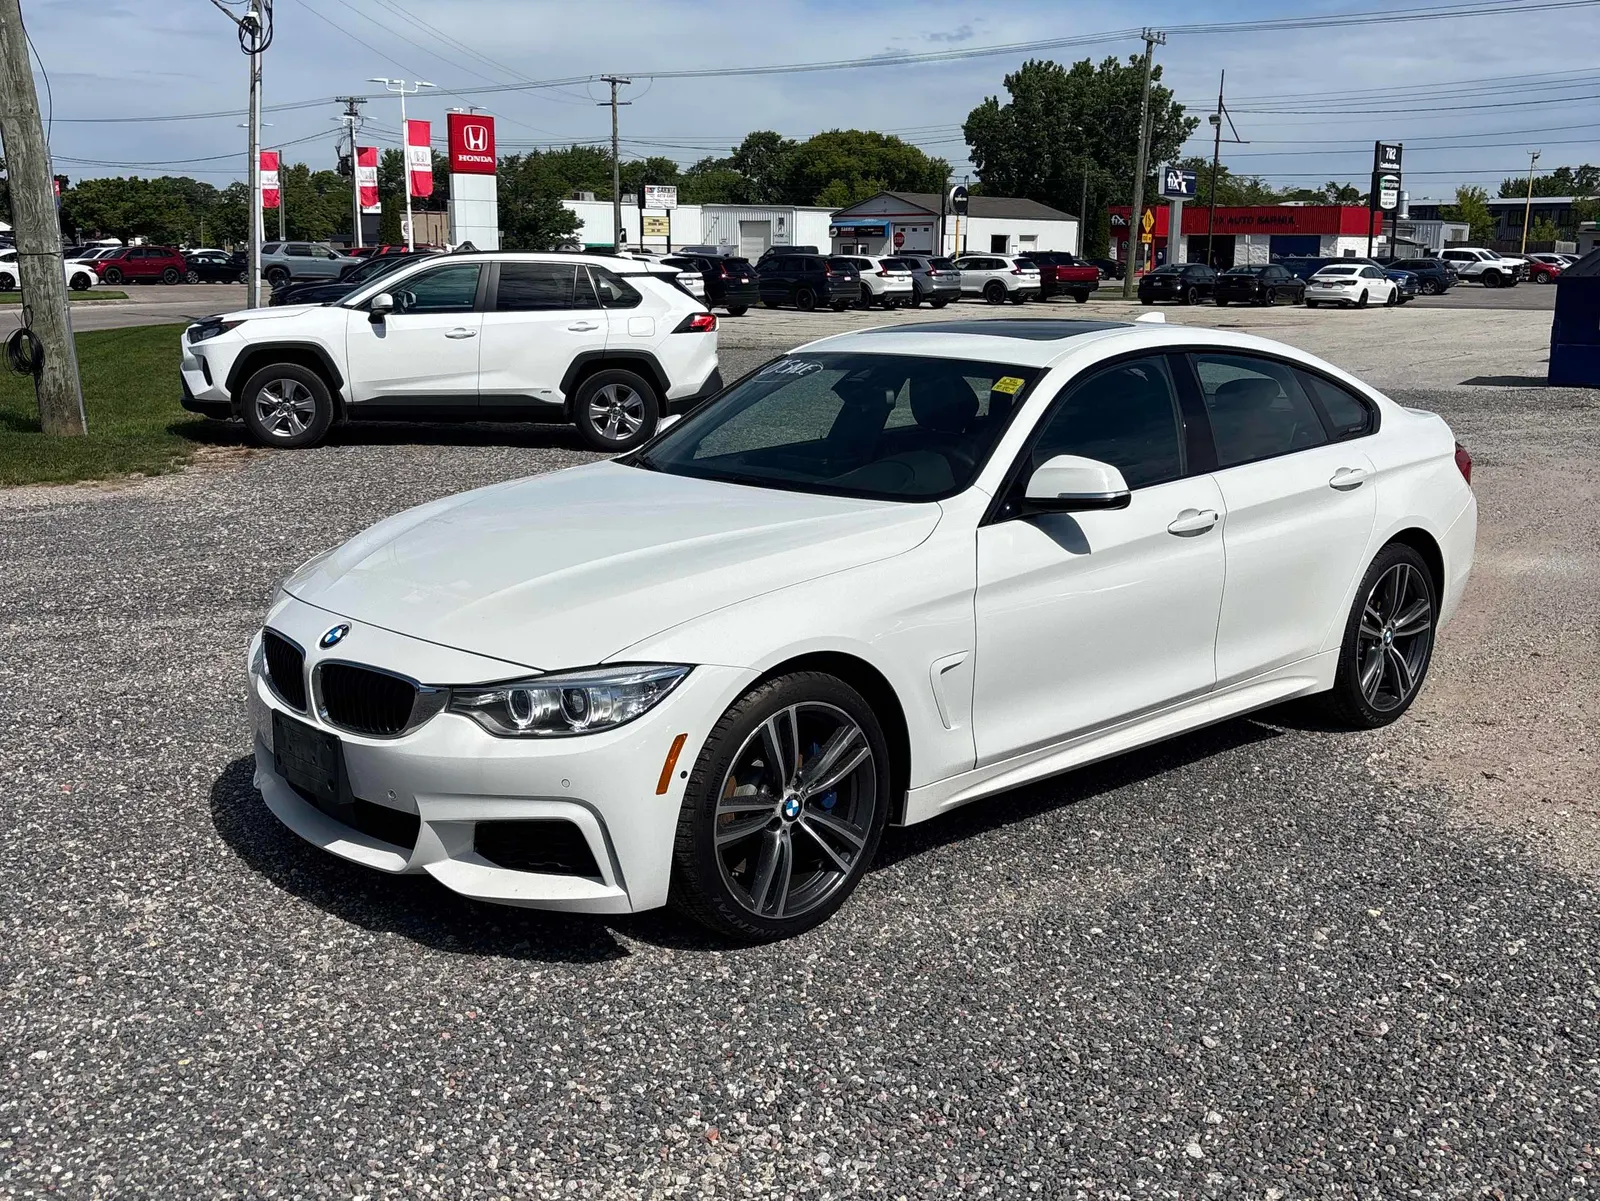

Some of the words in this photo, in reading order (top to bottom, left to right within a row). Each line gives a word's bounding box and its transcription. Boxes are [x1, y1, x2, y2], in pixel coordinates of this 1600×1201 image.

[458, 154, 493, 163] HONDA
[1386, 147, 1396, 160] 782
[1111, 215, 1126, 226] fix
[1228, 216, 1254, 225] AUTO
[1257, 216, 1295, 225] SARNIA
